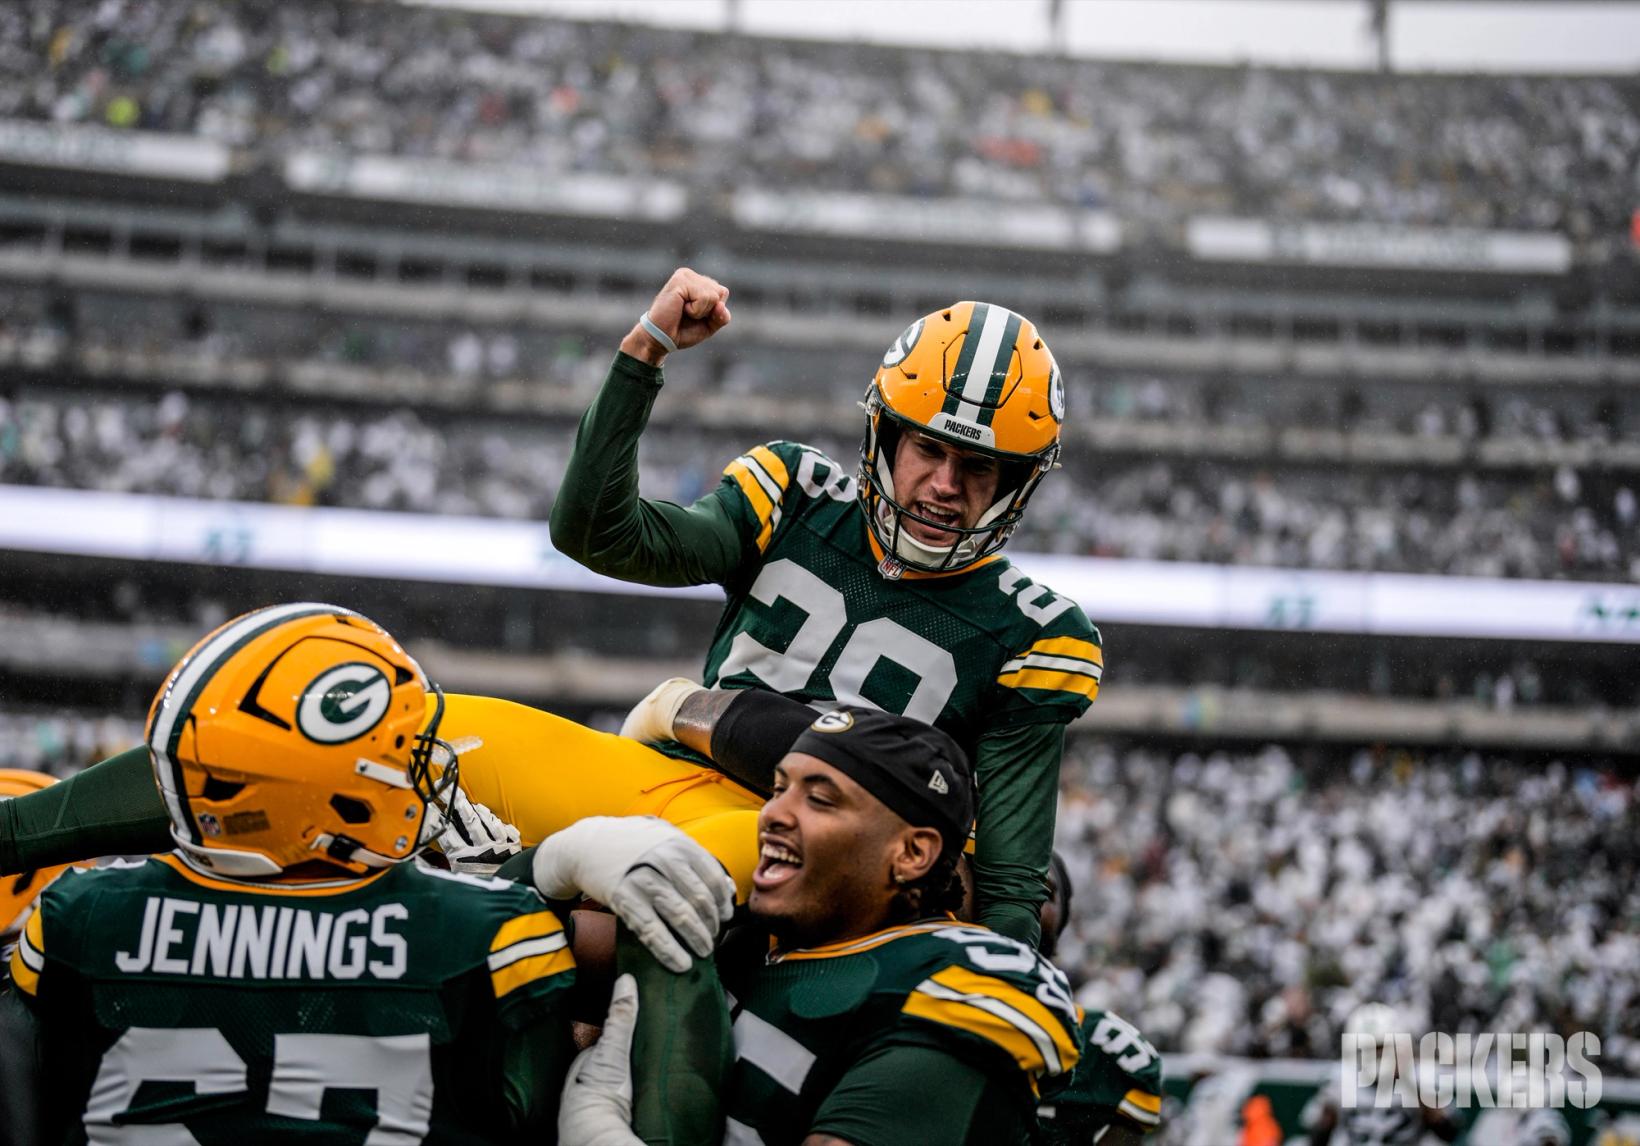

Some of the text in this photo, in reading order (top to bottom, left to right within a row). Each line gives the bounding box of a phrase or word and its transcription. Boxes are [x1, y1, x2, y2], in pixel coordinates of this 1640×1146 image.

[944, 419, 981, 440] PACKERS
[881, 560, 902, 577] NFL
[299, 664, 390, 742] G
[115, 897, 408, 980] JENNINGS
